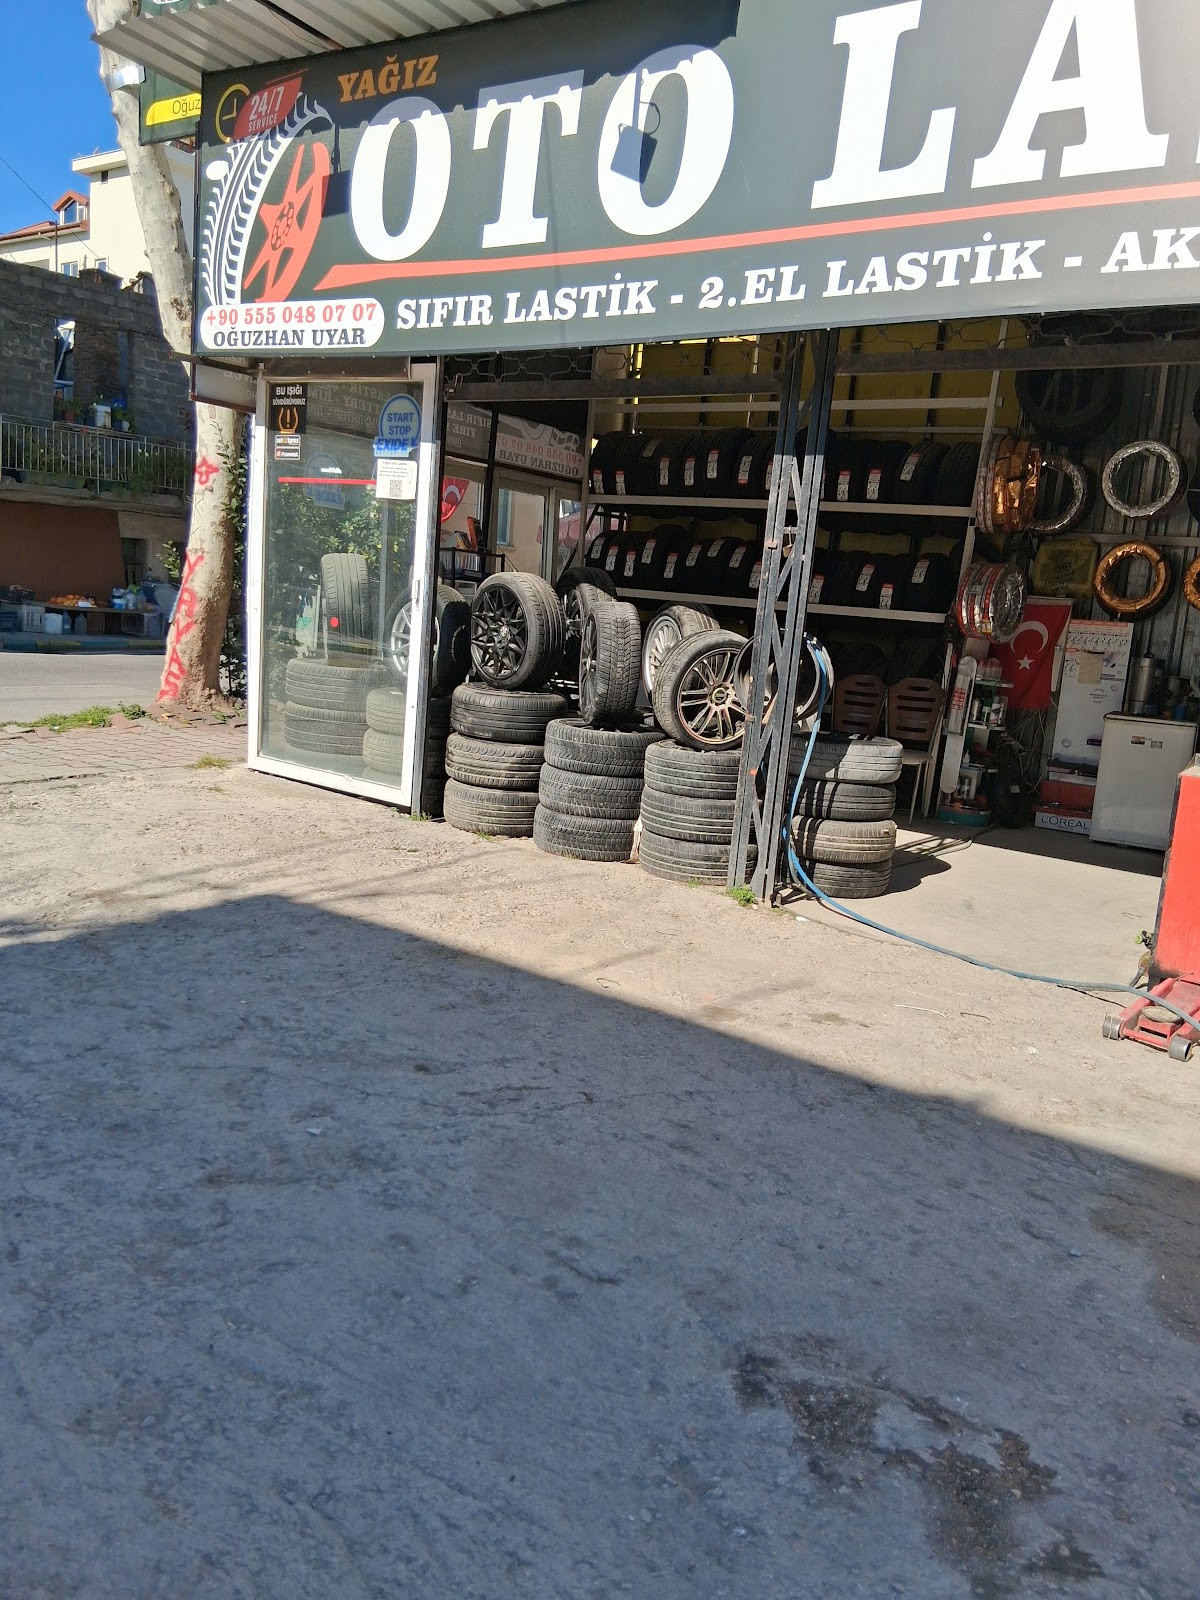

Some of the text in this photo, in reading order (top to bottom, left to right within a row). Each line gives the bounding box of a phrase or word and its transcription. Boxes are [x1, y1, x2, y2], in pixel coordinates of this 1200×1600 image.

[338, 55, 438, 103] YAĞIZ
[250, 86, 285, 119] 24/7
[248, 112, 279, 133] SERVICE
[351, 0, 1200, 262] OTO LA
[396, 294, 494, 330] SIFIR
[504, 272, 659, 324] LASTİK
[699, 265, 806, 310] 2.EL
[822, 231, 1046, 298] LASTİK
[207, 302, 378, 326] +90 555 048 07 07
[213, 326, 367, 347] OĞUZHAN UYAR
[276, 384, 303, 397] BU IŞIĞI
[387, 412, 414, 423] START
[388, 425, 411, 436] STOP
[375, 438, 409, 452] EXIDE
